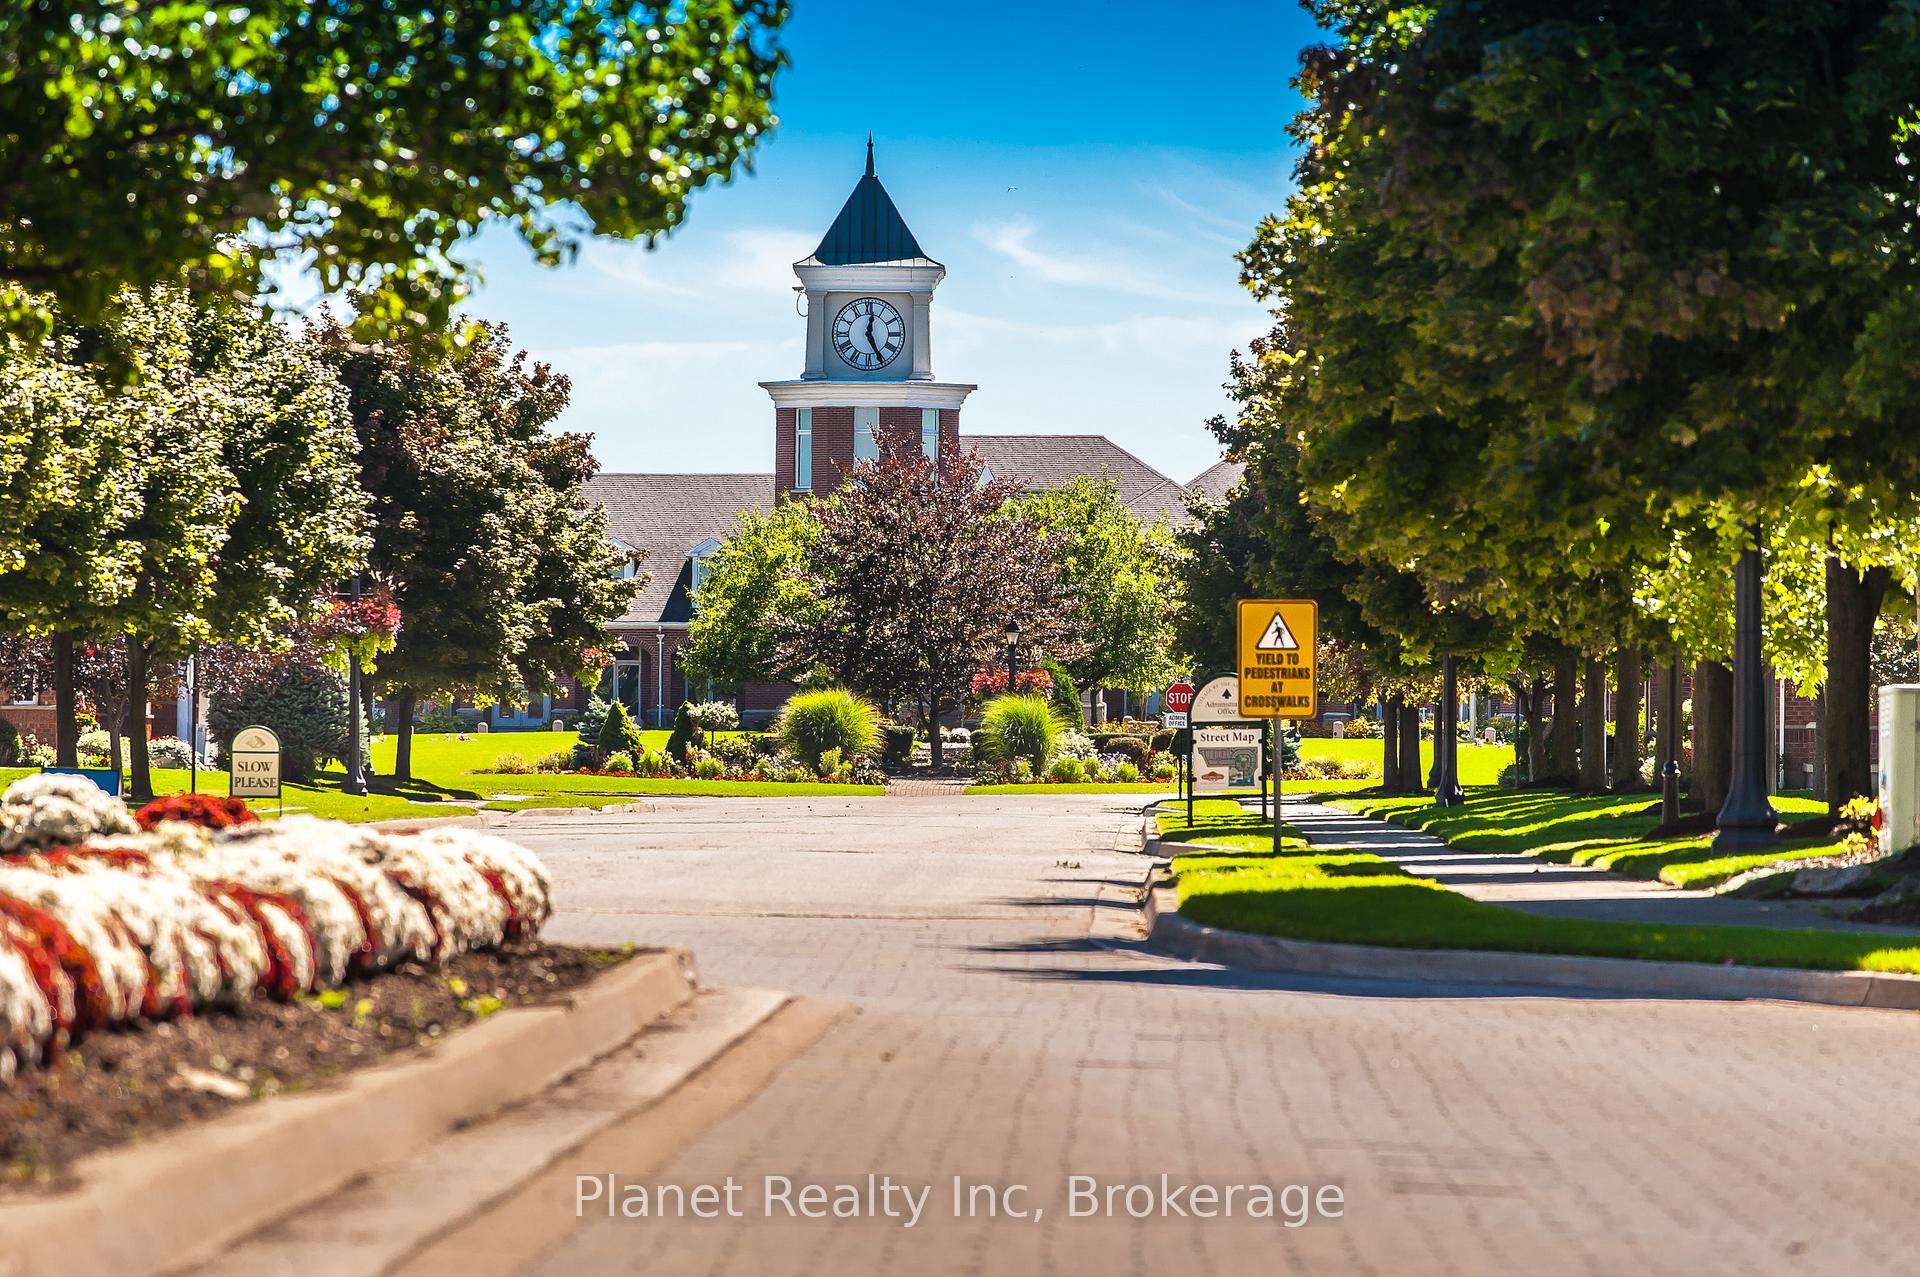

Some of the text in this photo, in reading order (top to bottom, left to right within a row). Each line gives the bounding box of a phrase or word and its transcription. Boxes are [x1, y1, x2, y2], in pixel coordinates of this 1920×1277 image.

[1256, 653, 1299, 665] YIELD TO
[1244, 667, 1311, 680] PEDESTRIANS
[1271, 681, 1284, 693] AT
[1244, 695, 1310, 708] CROSSWALKS
[1200, 732, 1255, 744] Street Map
[237, 761, 273, 772] SLOW
[234, 777, 277, 788] PLEASE
